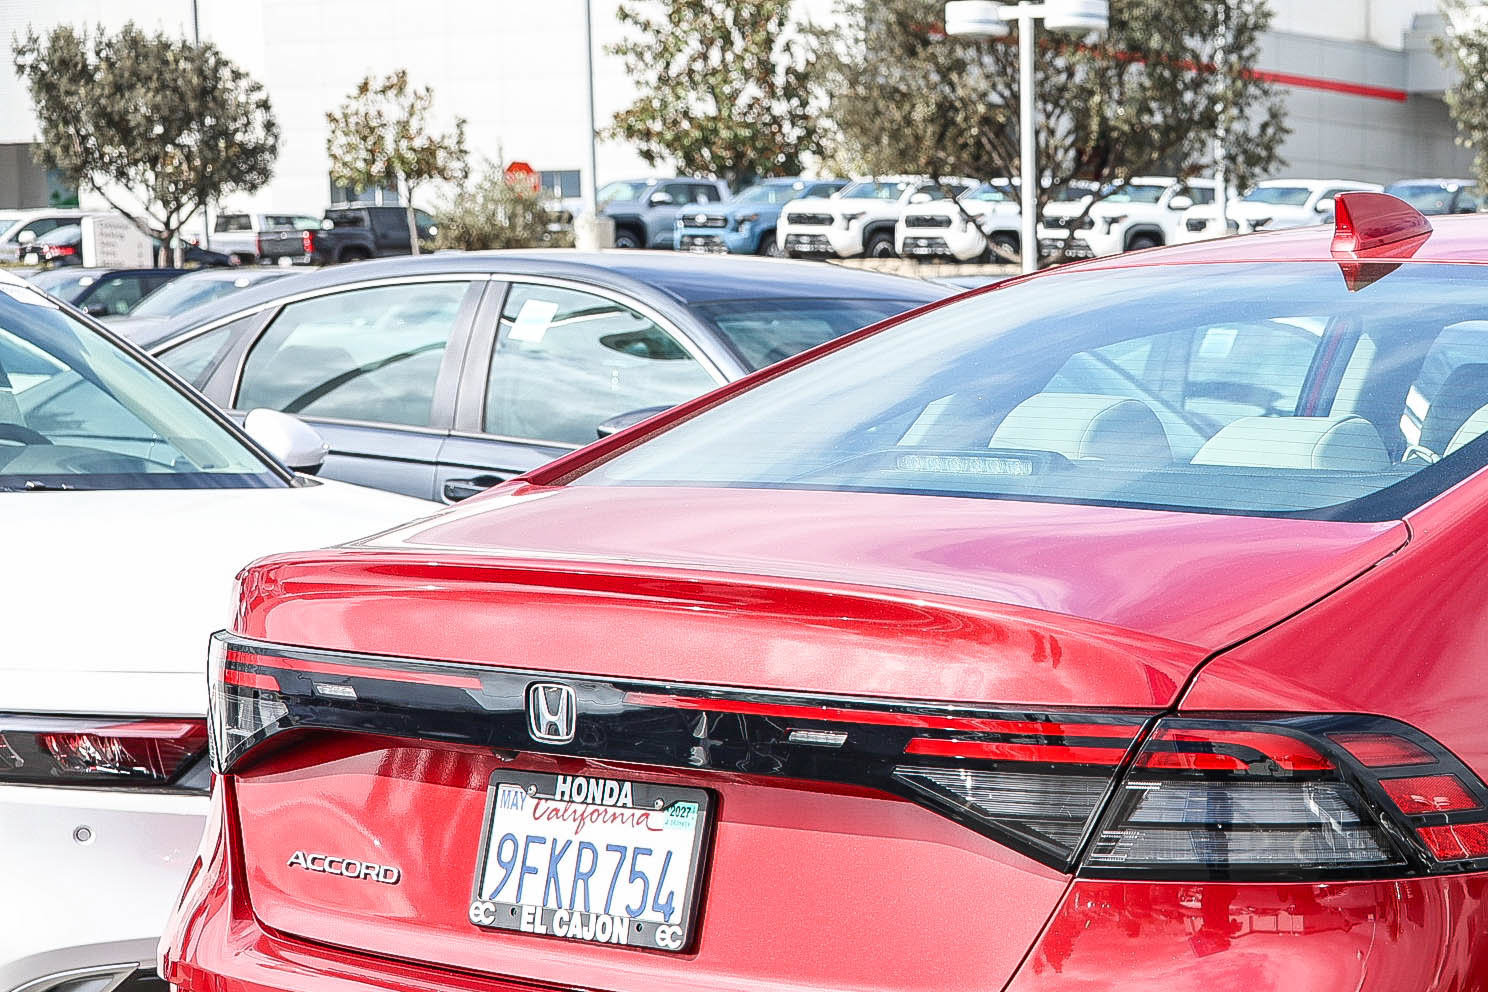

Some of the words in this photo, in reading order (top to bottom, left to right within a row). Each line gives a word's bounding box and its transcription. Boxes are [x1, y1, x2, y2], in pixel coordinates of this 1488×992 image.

[499, 789, 527, 811] MAY
[554, 775, 634, 808] HONDA
[532, 798, 664, 836] California
[669, 805, 692, 818] 2027
[286, 850, 401, 885] ACCORD
[489, 832, 675, 923] 9FKR754
[520, 905, 547, 934] EL
[552, 908, 631, 945] CAJON
